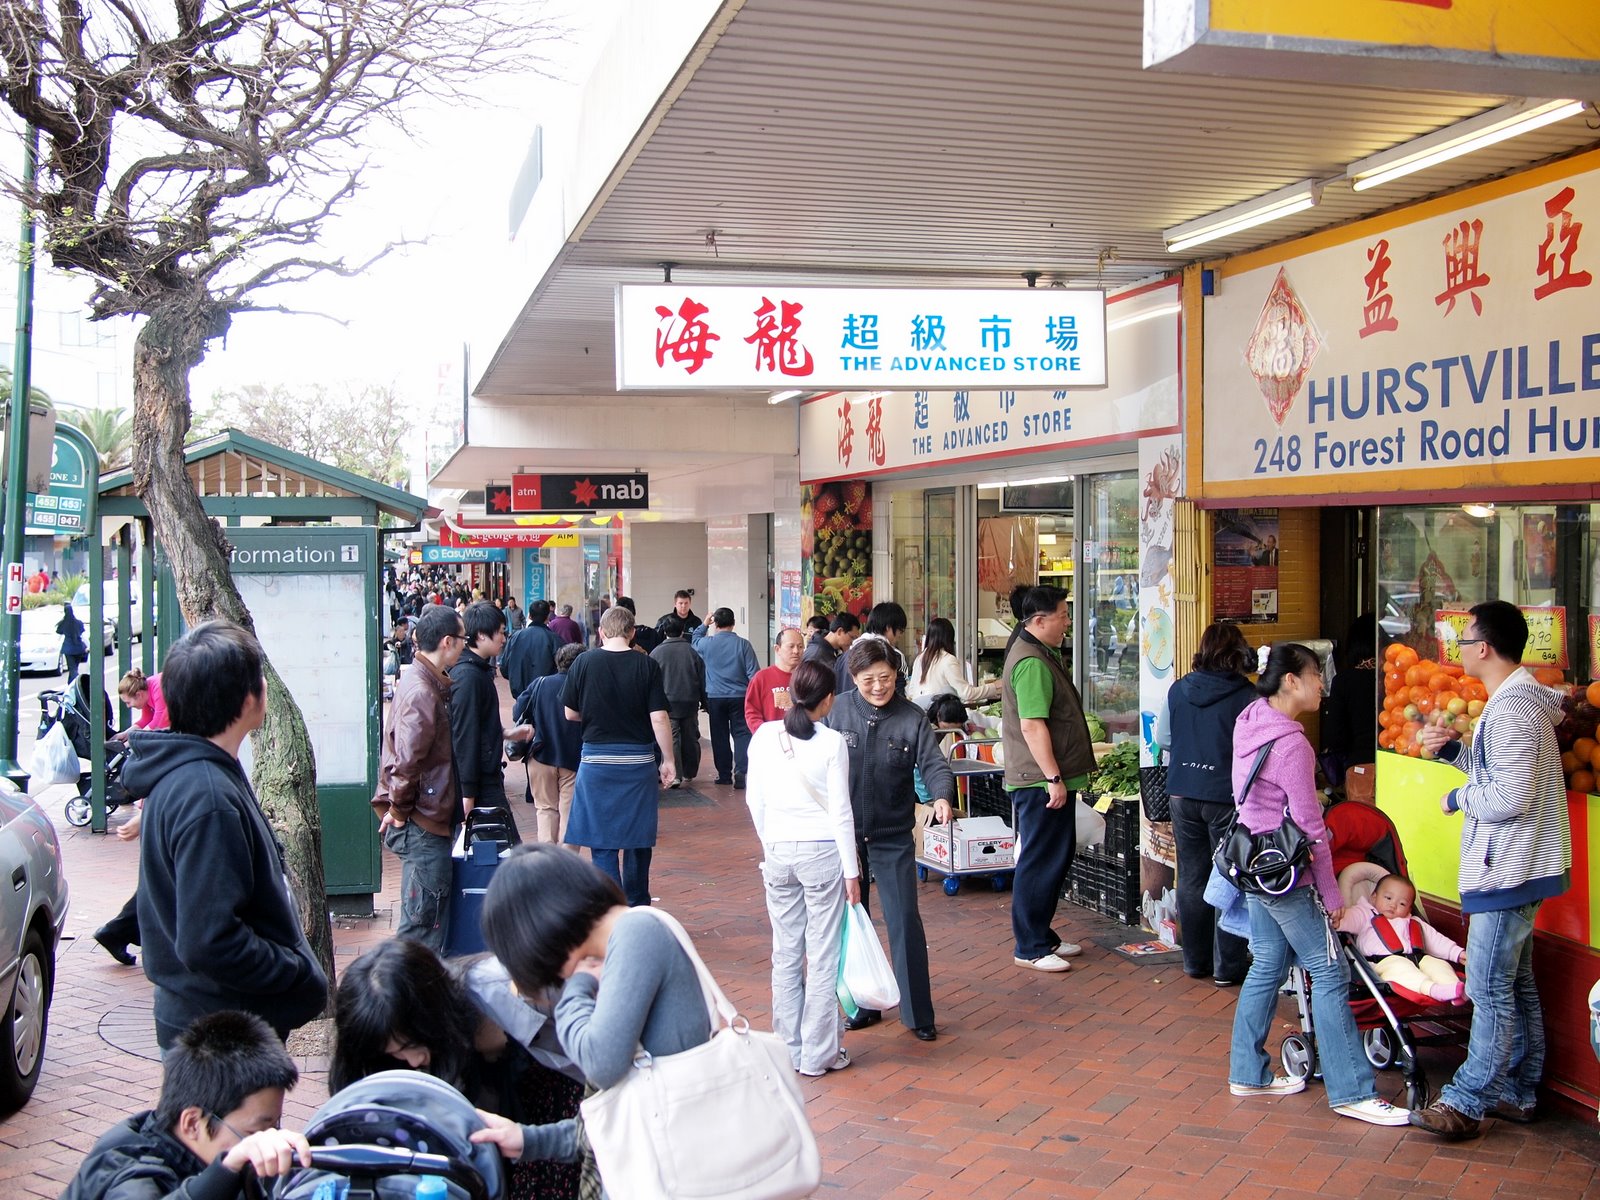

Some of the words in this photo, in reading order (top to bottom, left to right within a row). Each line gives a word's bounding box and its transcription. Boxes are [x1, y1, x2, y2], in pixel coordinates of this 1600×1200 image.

[841, 313, 1078, 352] 超級市場
[840, 356, 882, 371] THE
[890, 356, 1006, 371] ADVANCED
[1013, 356, 1081, 371] STORE
[1308, 333, 1600, 424] HURSTVILLE
[912, 435, 932, 456] THE
[943, 420, 1008, 451] ADVANCED
[1023, 407, 1072, 437] STORE
[1253, 434, 1301, 474] 248
[1314, 427, 1406, 469] Forest
[1420, 408, 1510, 461] Road
[49, 472, 68, 481] ONE
[517, 488, 537, 496] atm
[601, 479, 645, 500] nab
[39, 498, 55, 507] 452
[37, 514, 54, 523] 455
[60, 516, 78, 526] 947
[230, 546, 335, 563] formation
[441, 549, 489, 560] EasyWay
